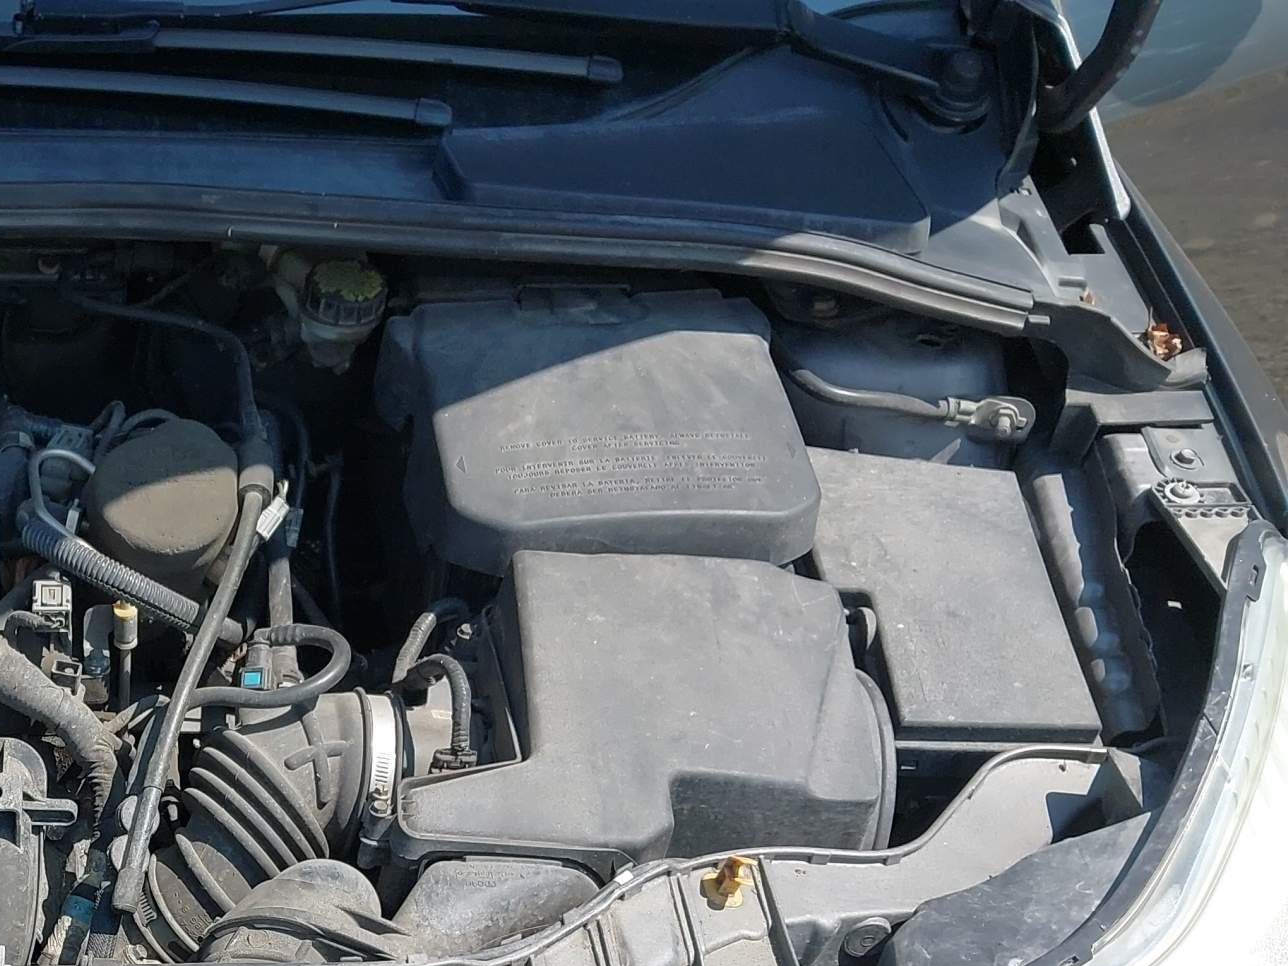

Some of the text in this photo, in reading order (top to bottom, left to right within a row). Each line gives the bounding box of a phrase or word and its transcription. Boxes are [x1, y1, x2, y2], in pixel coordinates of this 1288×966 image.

[535, 439, 562, 448] COVER
[571, 442, 599, 452] COVER
[522, 460, 574, 471] INTERVENIR
[507, 469, 550, 481] TOUJOURS
[554, 465, 591, 476] REPOSER
[540, 481, 578, 492] REVISAR
